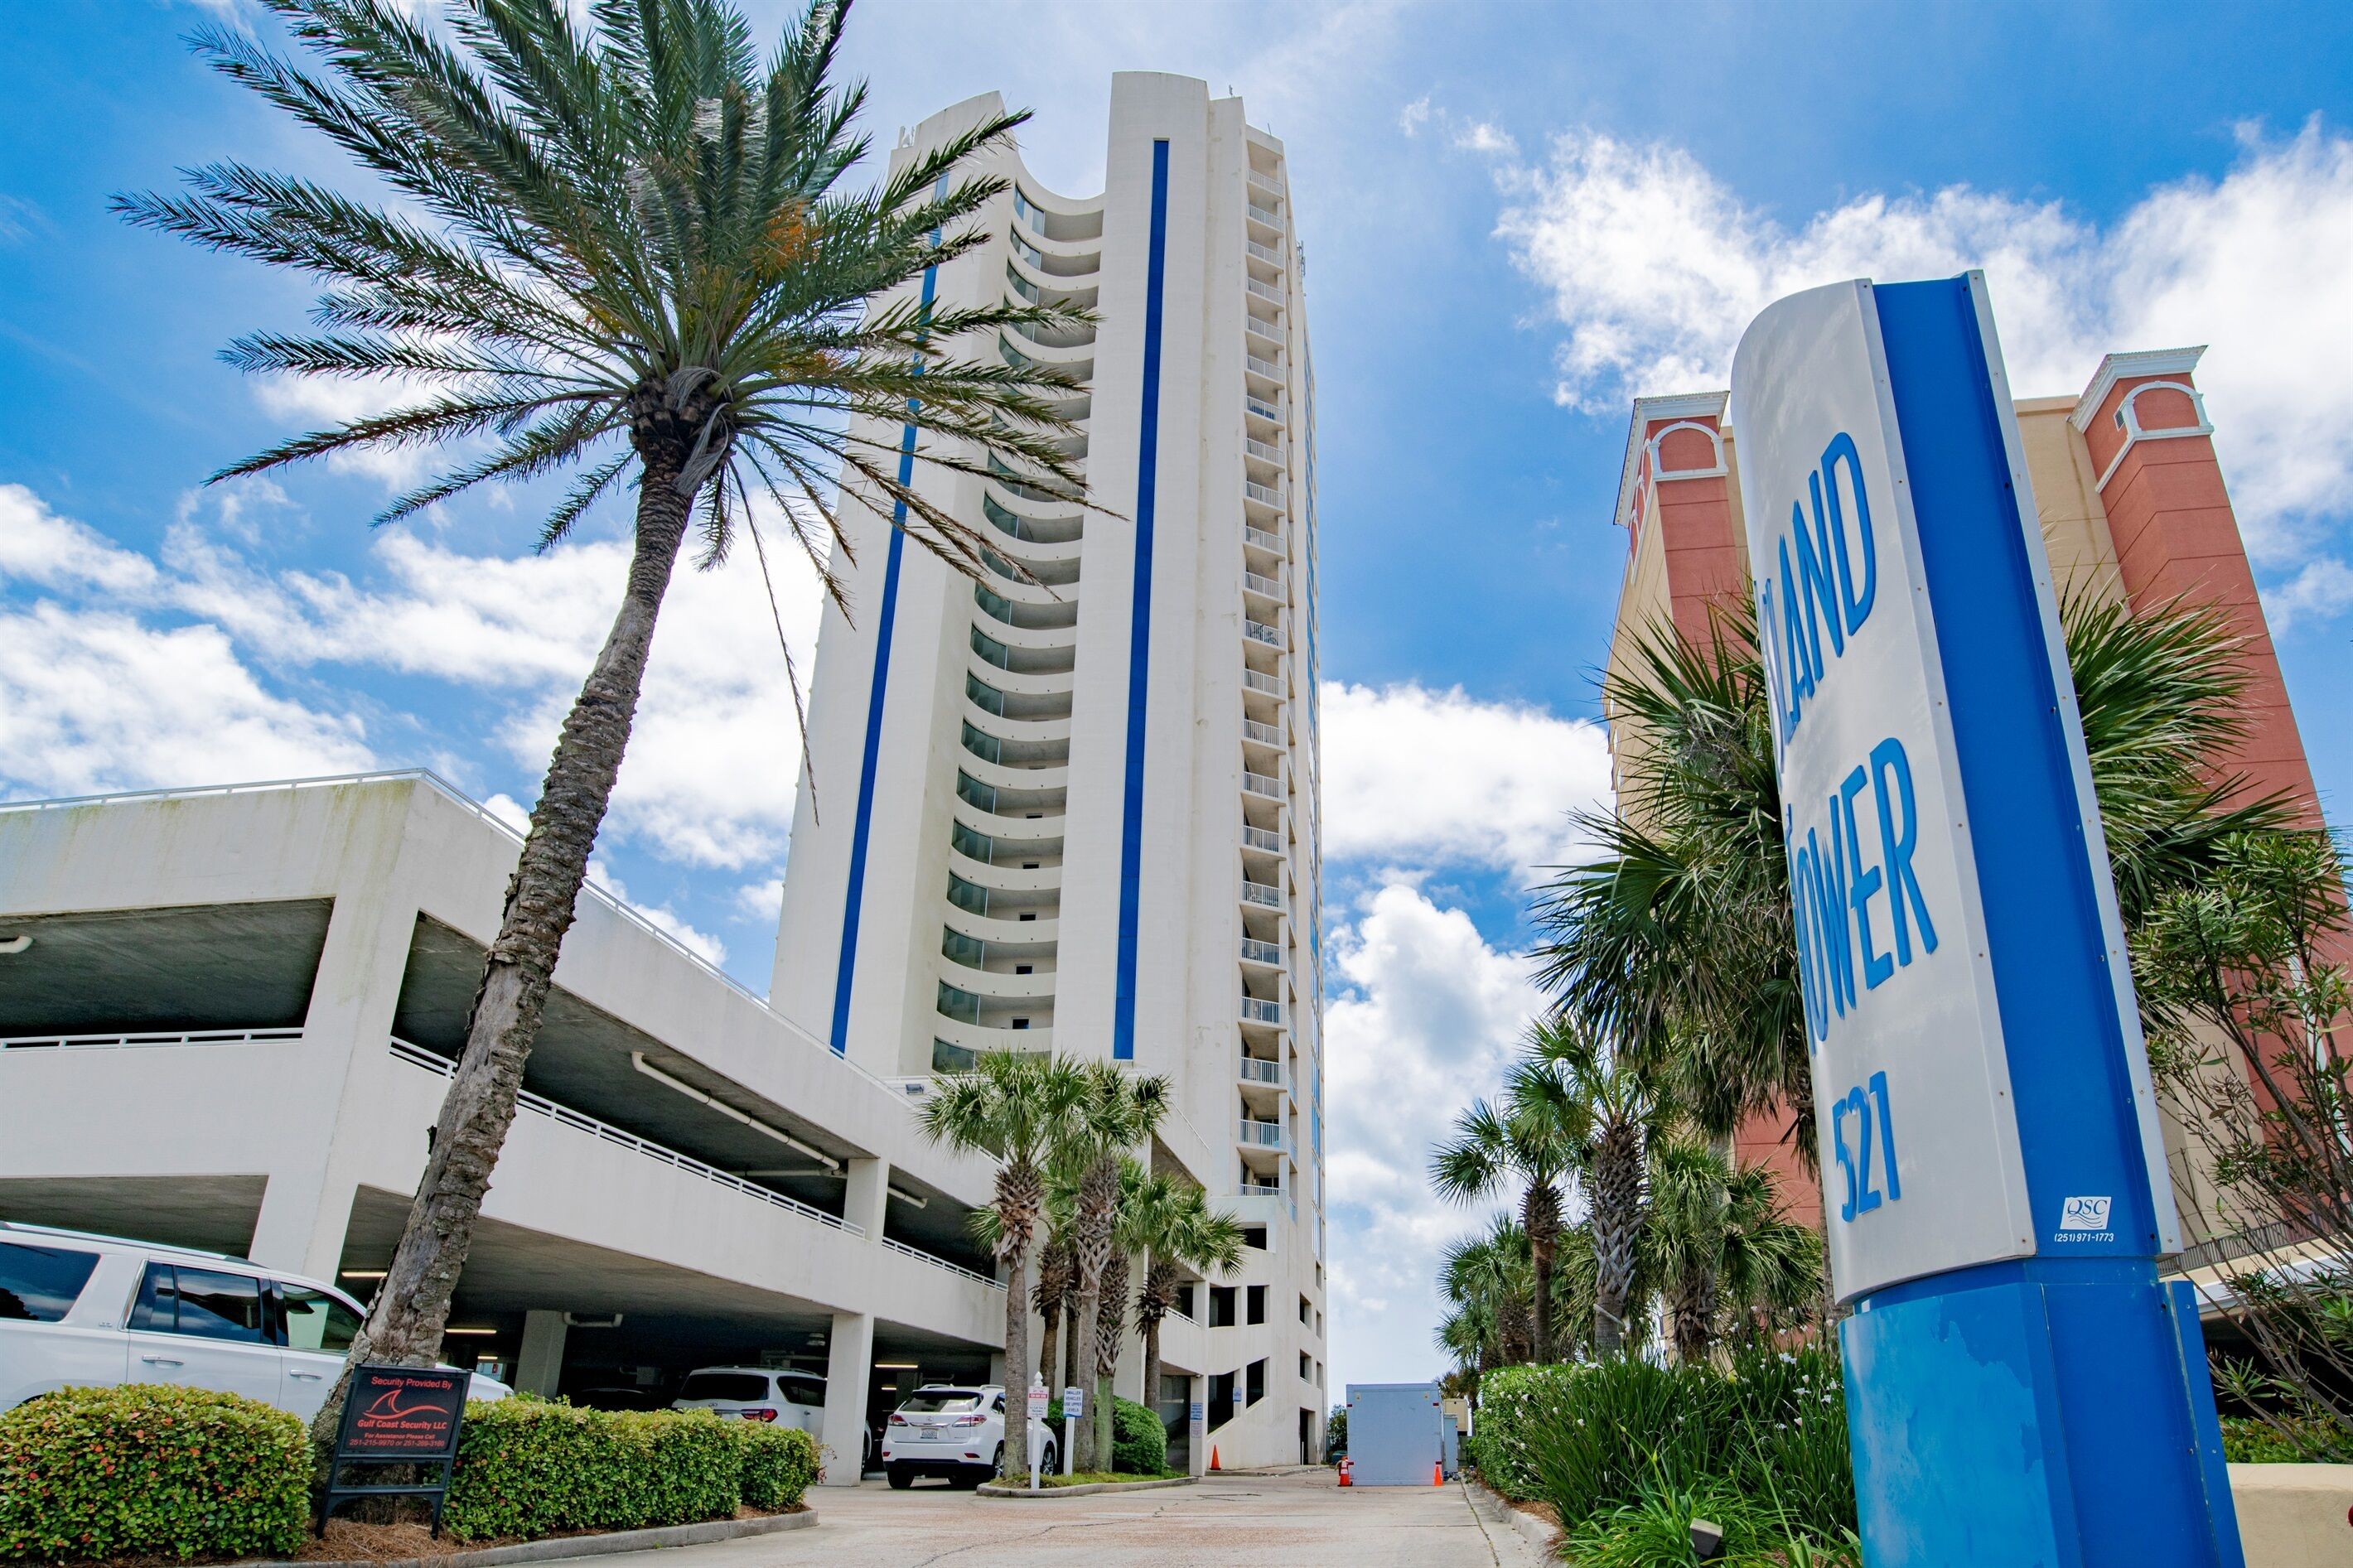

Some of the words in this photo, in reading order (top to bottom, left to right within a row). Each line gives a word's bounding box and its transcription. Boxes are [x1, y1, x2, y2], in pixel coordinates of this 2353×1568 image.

[1832, 1070, 1901, 1223] 521
[2067, 1199, 2108, 1218] QSC
[371, 1376, 404, 1387] Security
[406, 1378, 441, 1388] Provided
[442, 1380, 452, 1390] By
[357, 1419, 375, 1428] Gulf
[377, 1420, 398, 1429] Coast
[399, 1421, 432, 1430] Security
[432, 1421, 447, 1430] LLC
